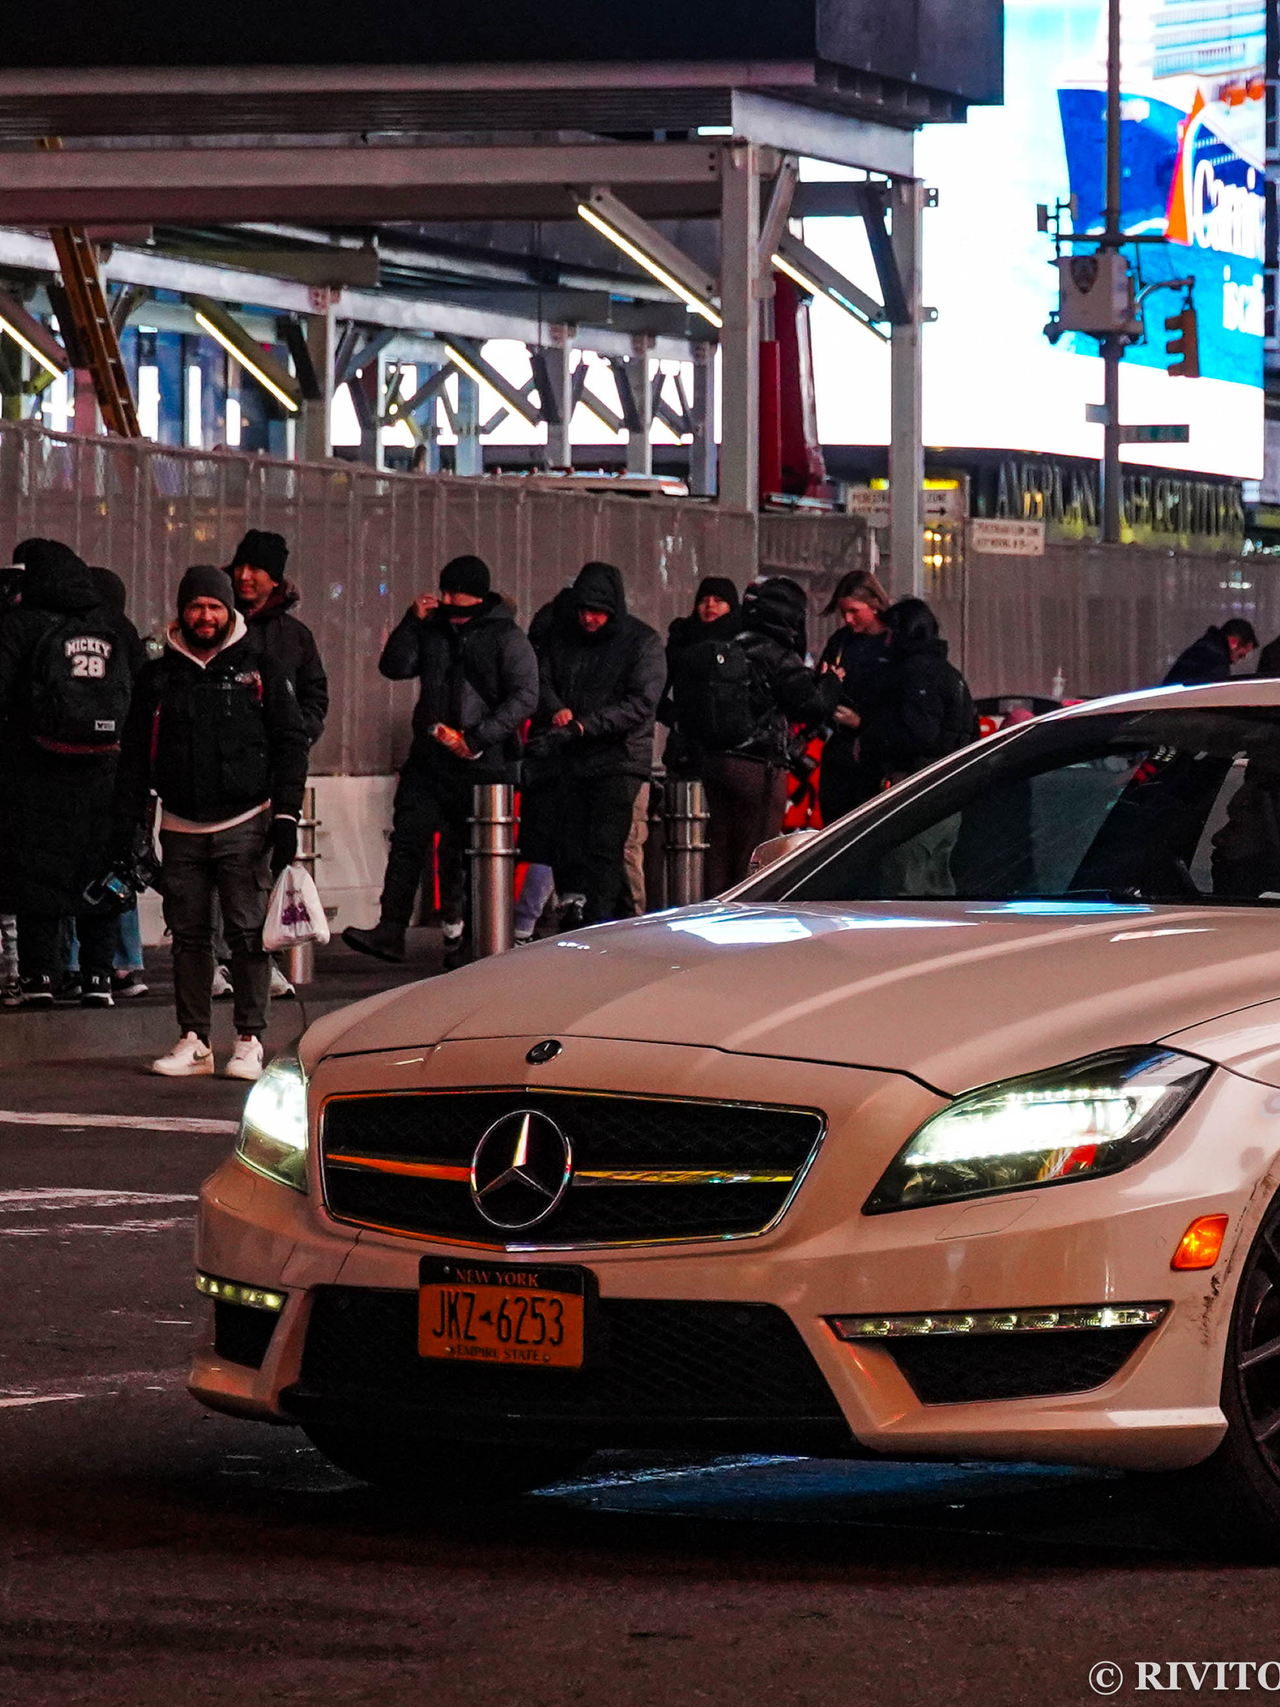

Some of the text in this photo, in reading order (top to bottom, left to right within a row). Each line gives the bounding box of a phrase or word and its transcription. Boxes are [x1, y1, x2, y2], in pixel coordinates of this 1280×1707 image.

[65, 636, 112, 659] MICKEY
[455, 1268, 539, 1288] NEW YORK
[456, 1343, 539, 1361] EMPIRE STATE
